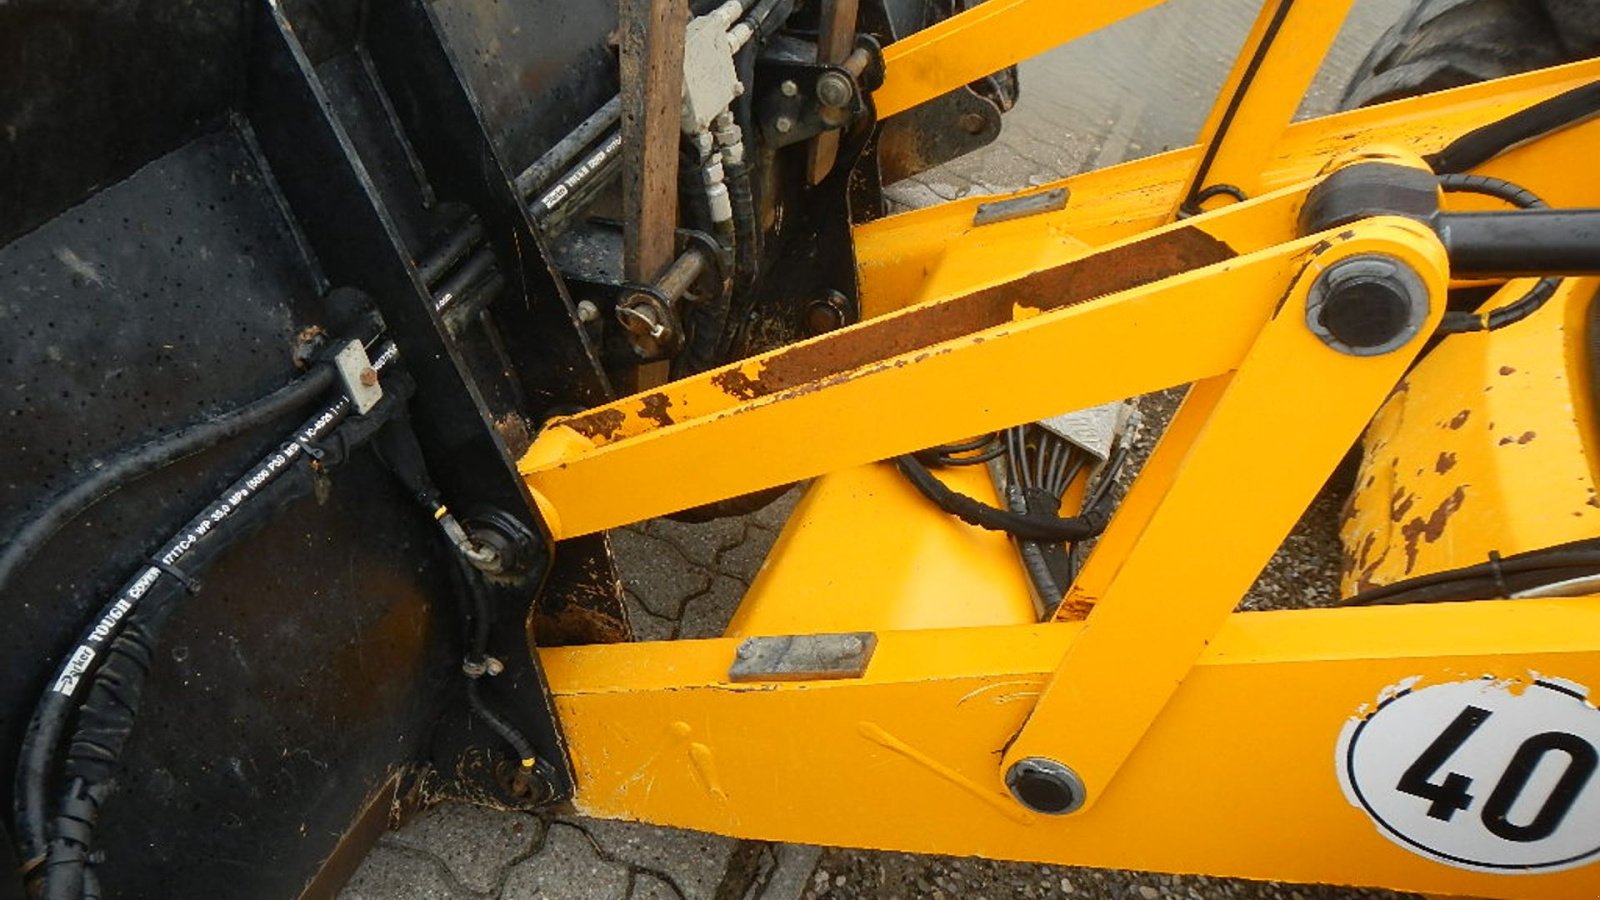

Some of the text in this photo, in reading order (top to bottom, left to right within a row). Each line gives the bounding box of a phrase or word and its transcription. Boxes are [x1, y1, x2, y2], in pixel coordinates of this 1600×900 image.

[56, 647, 94, 692] Parker
[88, 598, 132, 642] TOUGH
[128, 566, 162, 600] COVER
[195, 520, 211, 536] WP
[1395, 704, 1599, 843] 40
